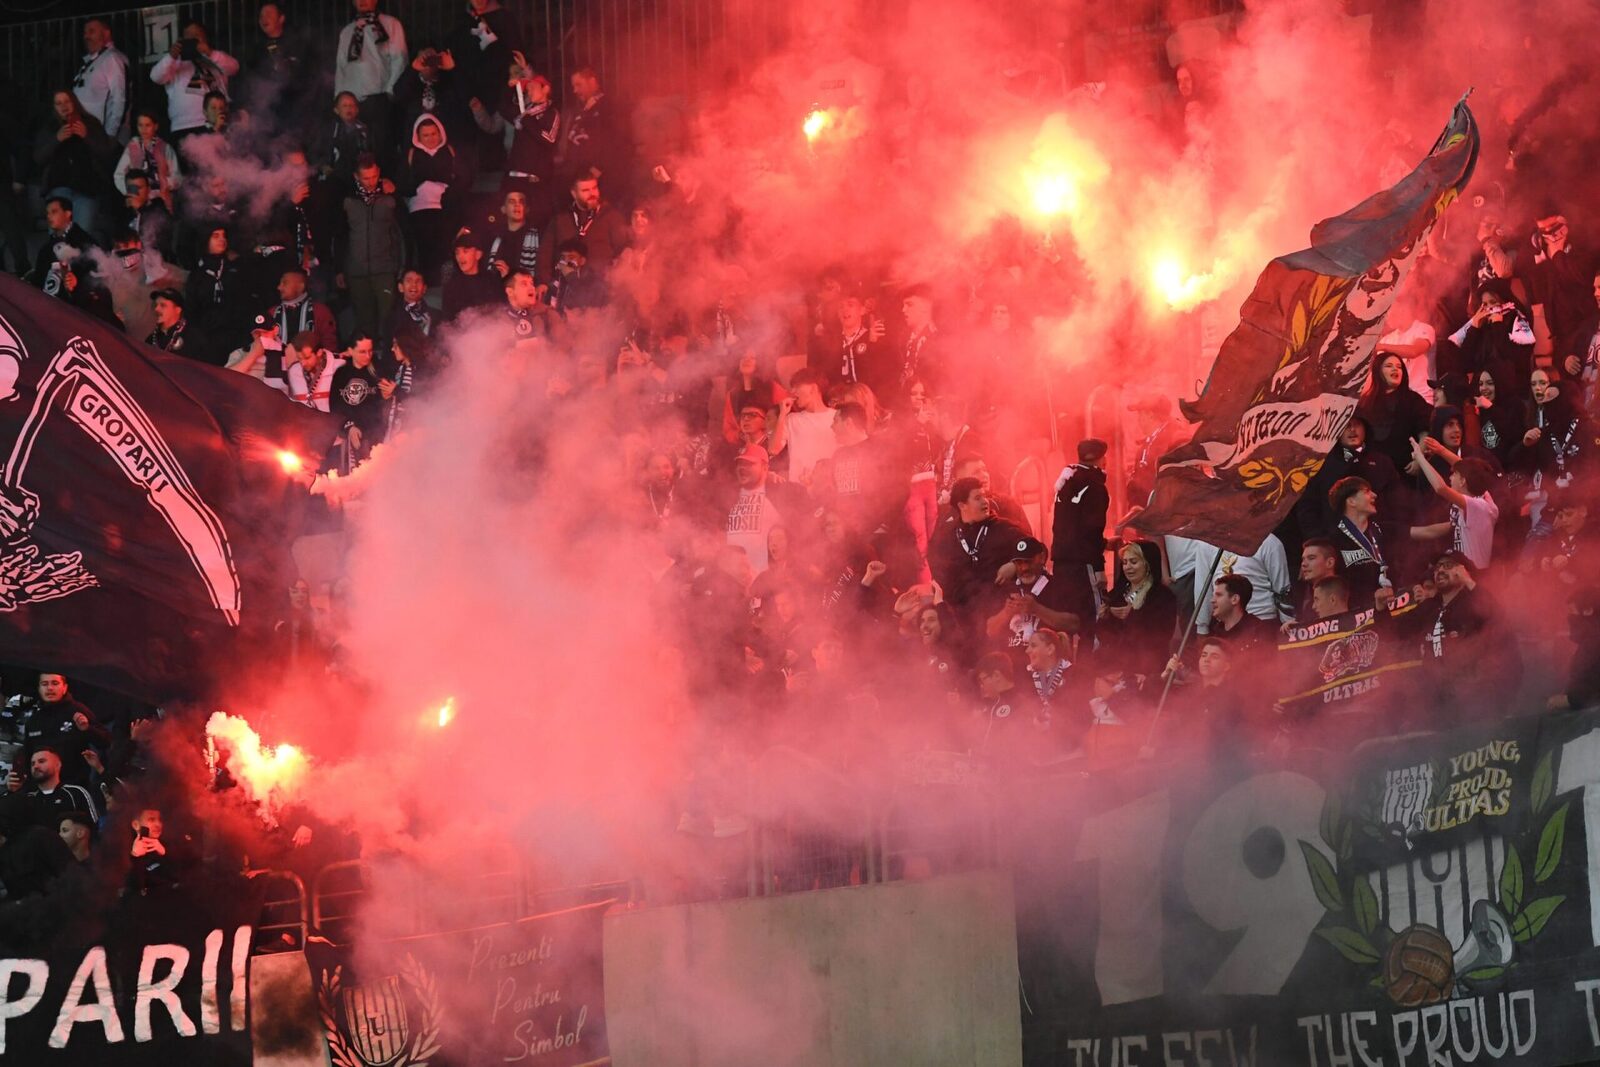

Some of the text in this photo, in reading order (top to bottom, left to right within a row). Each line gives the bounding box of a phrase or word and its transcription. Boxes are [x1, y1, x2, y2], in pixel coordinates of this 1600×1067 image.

[80, 394, 169, 493] GROPARII
[1288, 619, 1339, 642] YOUNG
[1323, 676, 1380, 703] ULTRAS
[0, 925, 252, 1055] PARII
[491, 976, 562, 1025] Pentru
[369, 1014, 386, 1036] U
[503, 1004, 588, 1062] Simbol
[1297, 1010, 1384, 1067] THE
[1391, 989, 1537, 1067] PROUD
